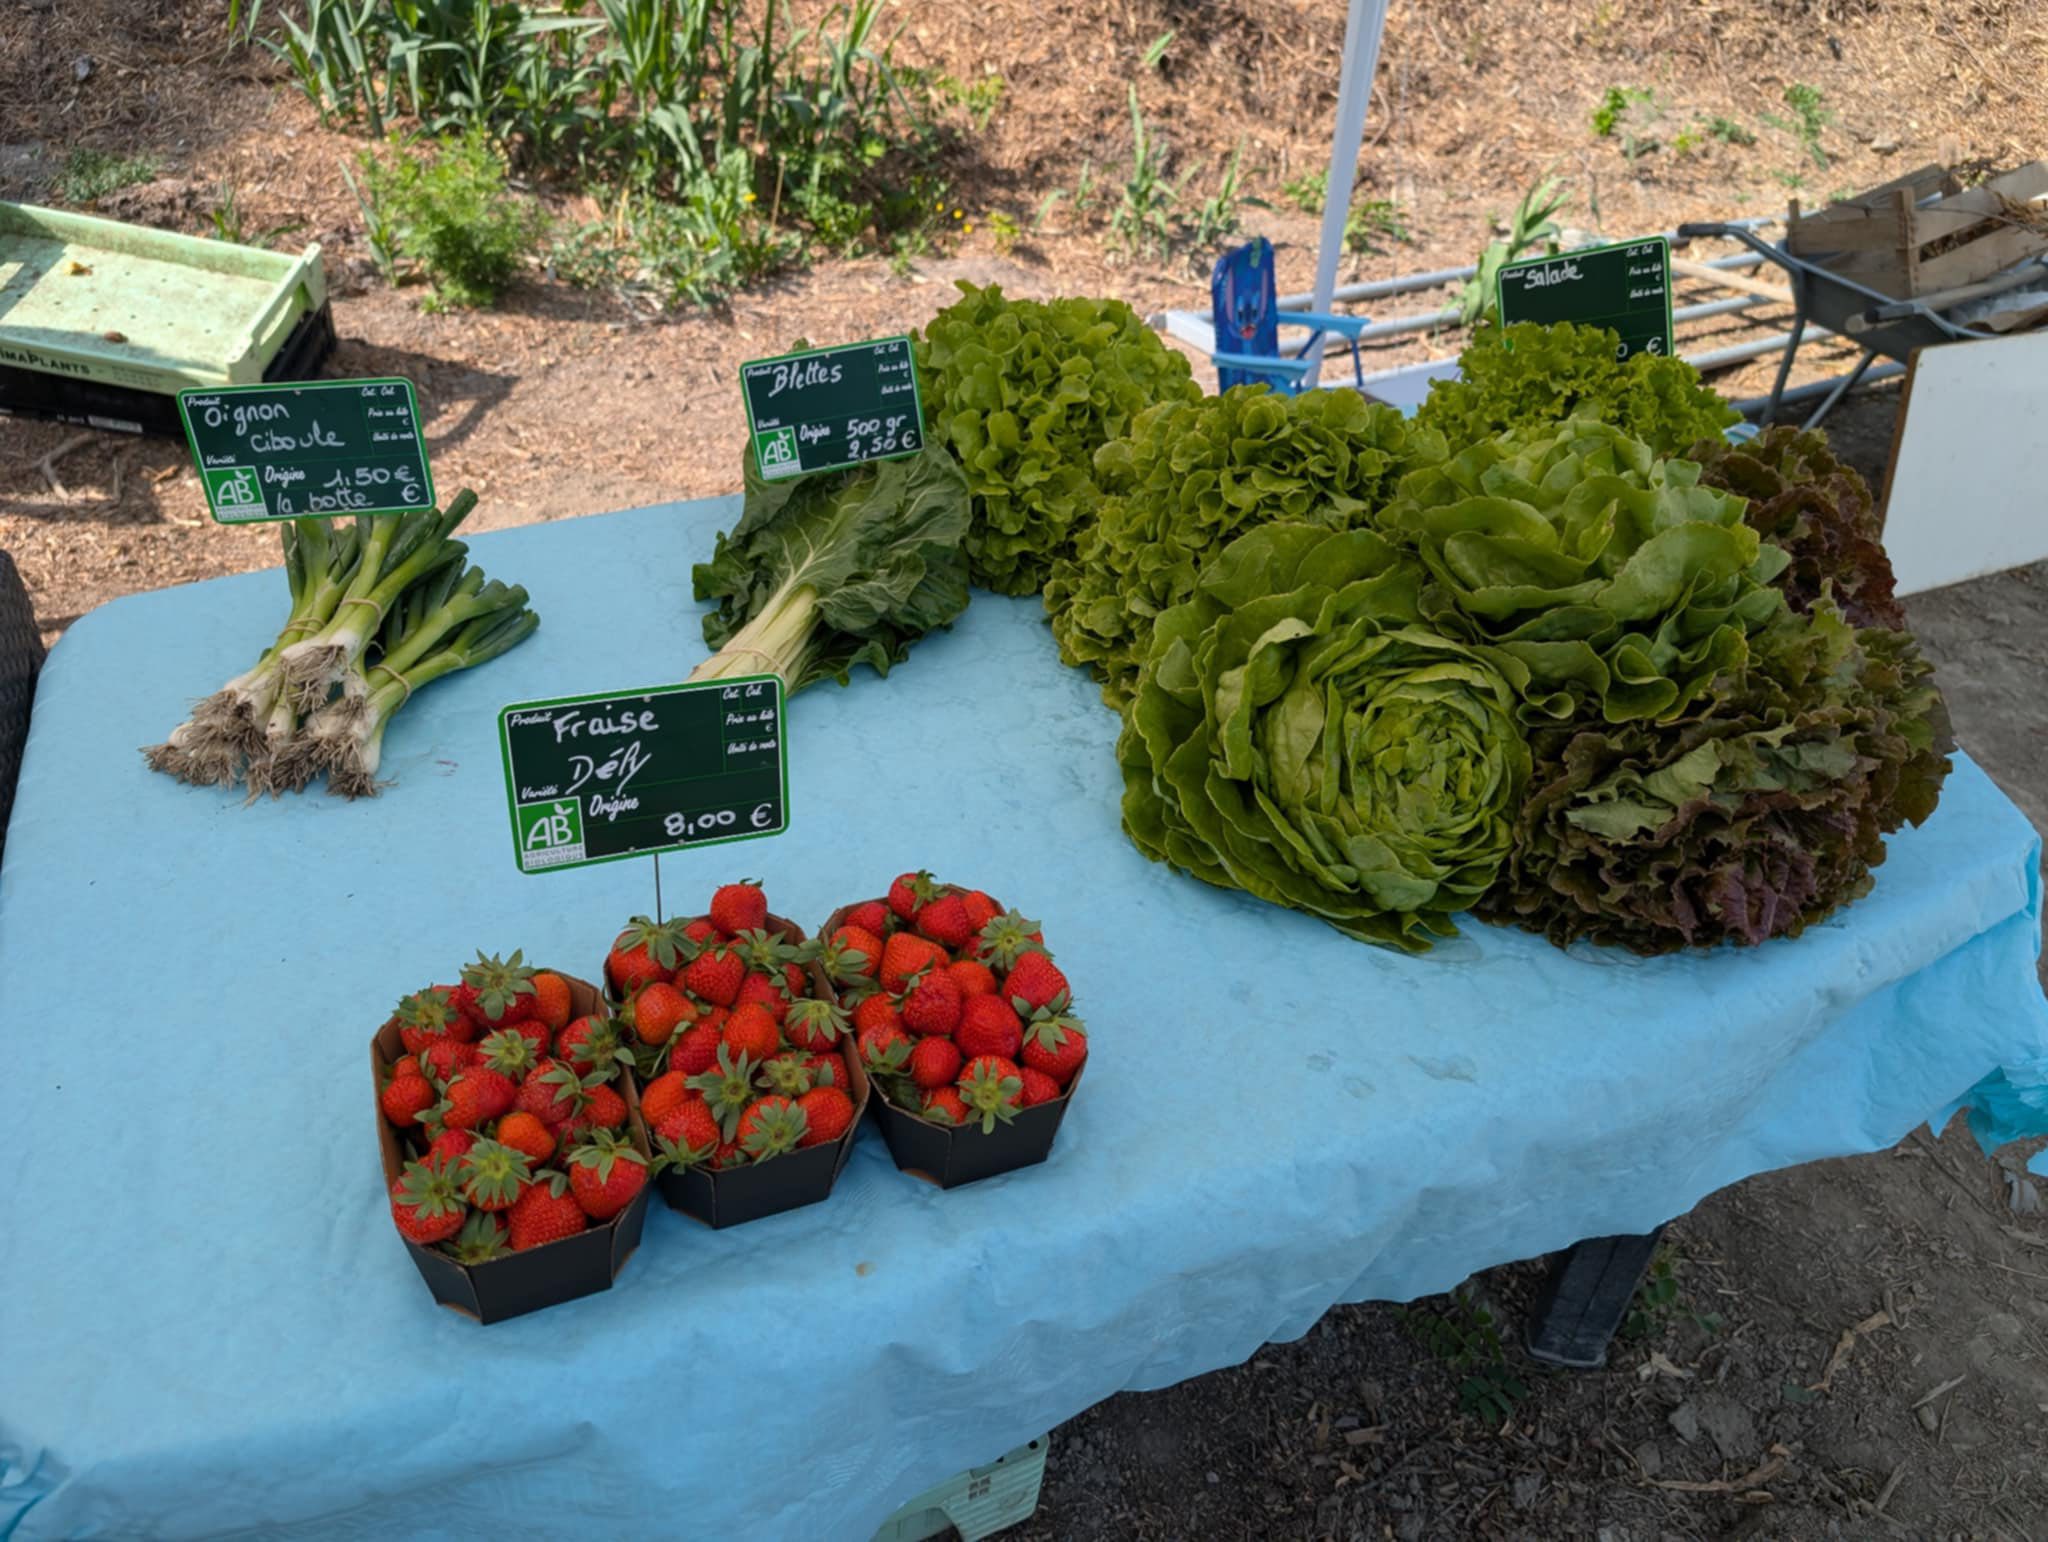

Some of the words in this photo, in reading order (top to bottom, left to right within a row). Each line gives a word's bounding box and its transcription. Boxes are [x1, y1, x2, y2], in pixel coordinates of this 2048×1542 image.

[768, 361, 842, 397] Blettes
[205, 403, 290, 437] Oignon
[846, 418, 881, 440] 500
[886, 413, 907, 437] gr
[763, 440, 792, 465] AB
[901, 430, 917, 449] €
[265, 465, 305, 489] Origine
[217, 479, 255, 506] AB
[277, 492, 293, 514] la
[309, 487, 374, 513] botte
[401, 483, 420, 503] €
[511, 711, 553, 728] Produit
[552, 704, 660, 743] Fraise
[521, 784, 558, 800] Variété
[589, 794, 640, 822] Origine
[527, 816, 573, 850] AB
[664, 810, 736, 836] 8,00
[750, 803, 772, 828] €
